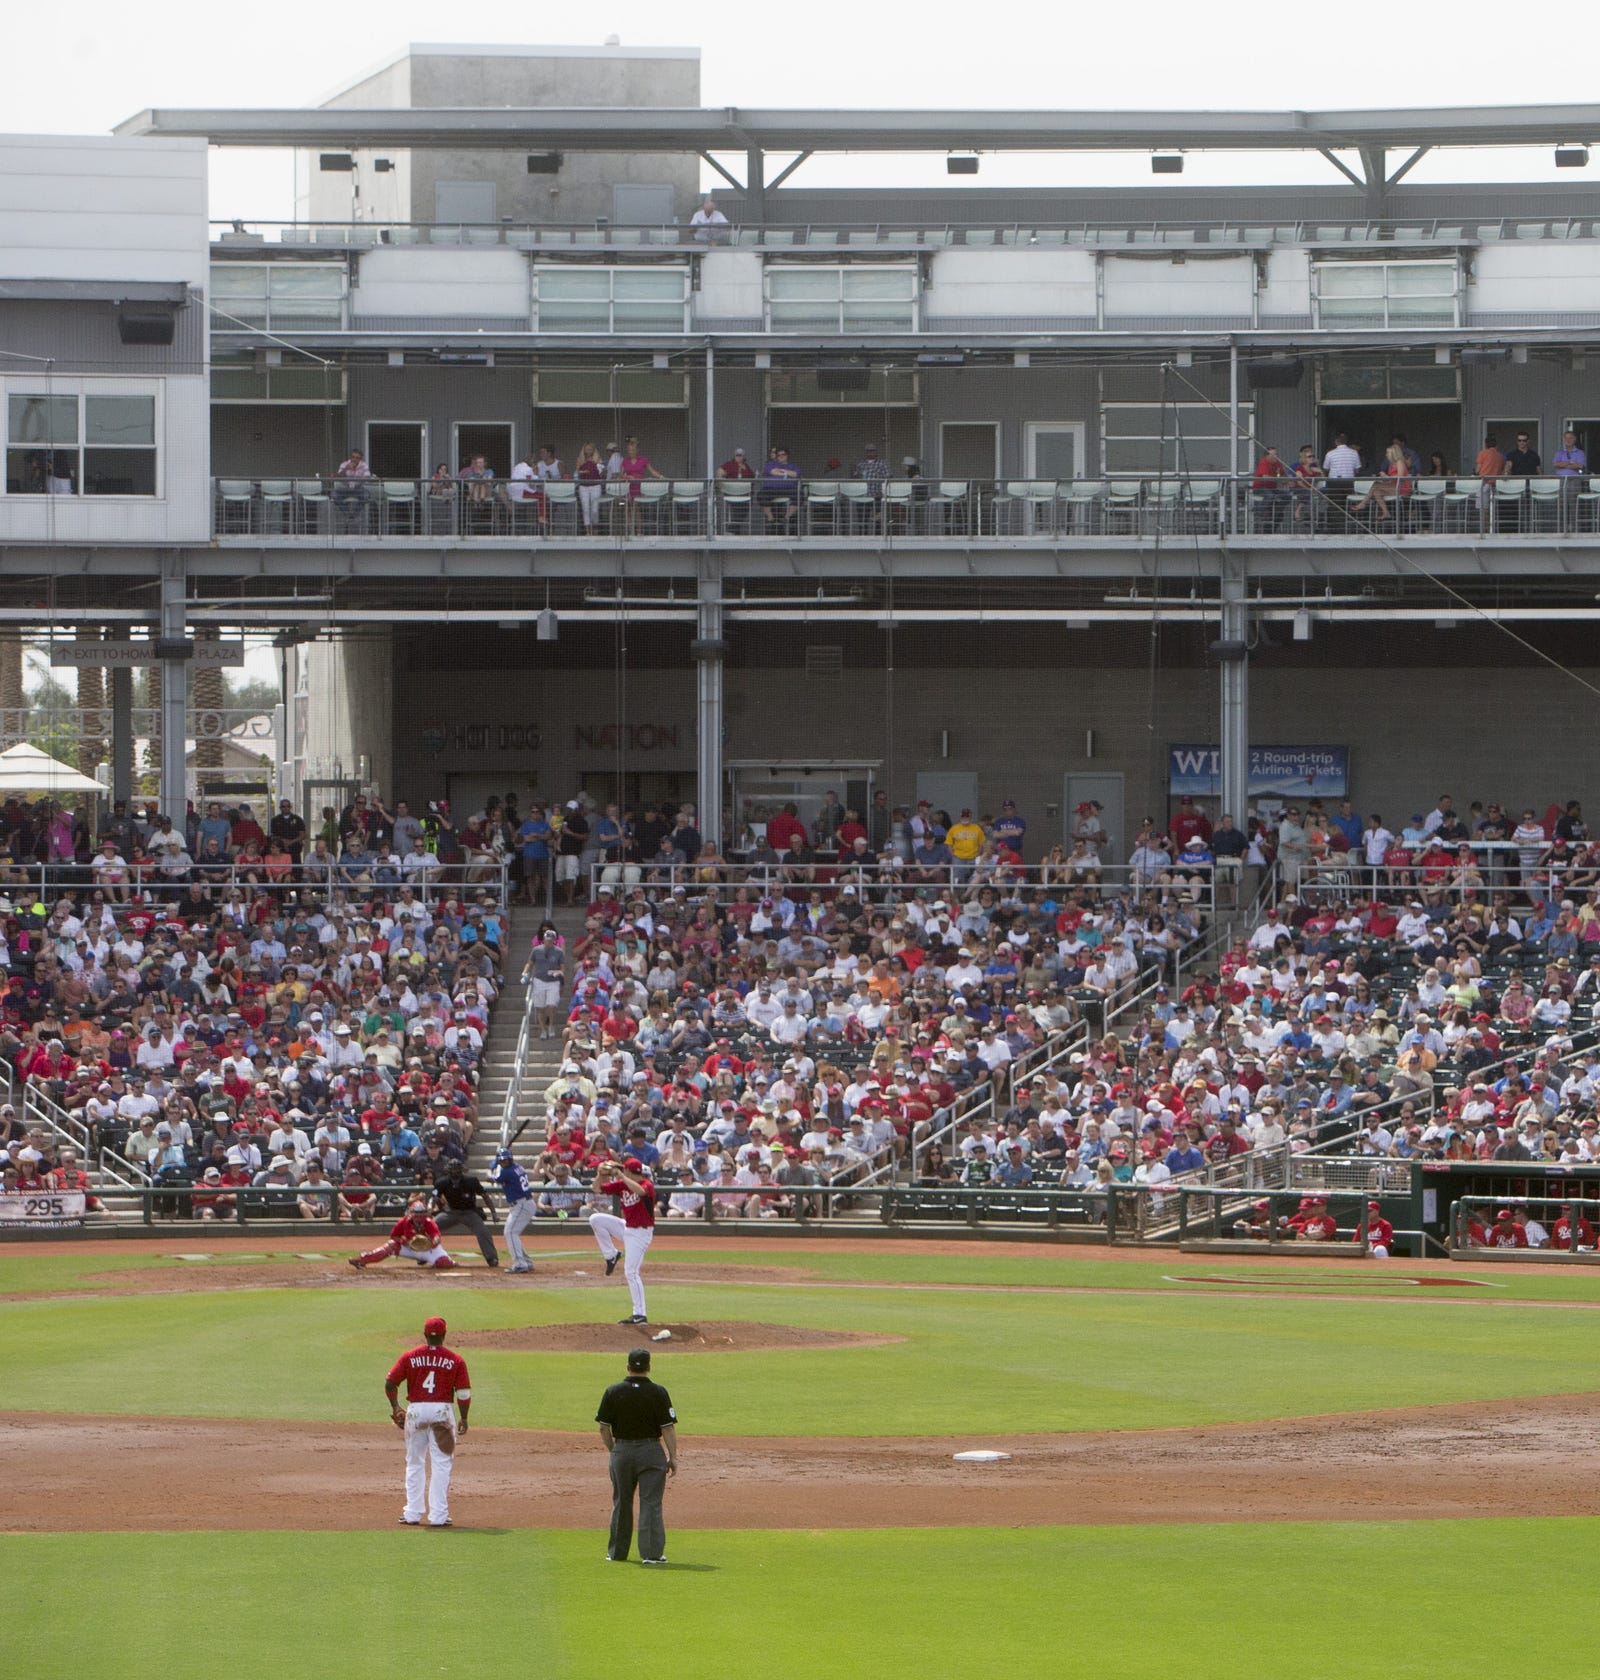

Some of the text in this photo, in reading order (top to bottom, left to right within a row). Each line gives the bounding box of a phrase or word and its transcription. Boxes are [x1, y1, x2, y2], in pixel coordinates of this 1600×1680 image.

[74, 648, 97, 659] EXIT
[103, 648, 118, 659] TO
[200, 648, 237, 659] PLAZA
[1173, 751, 1334, 774] WI 2 Round-trip
[1252, 764, 1342, 775] Airline Tickets
[27, 1198, 64, 1216] 295
[410, 1355, 455, 1371] PHILLIPS
[422, 1371, 435, 1394] 4
